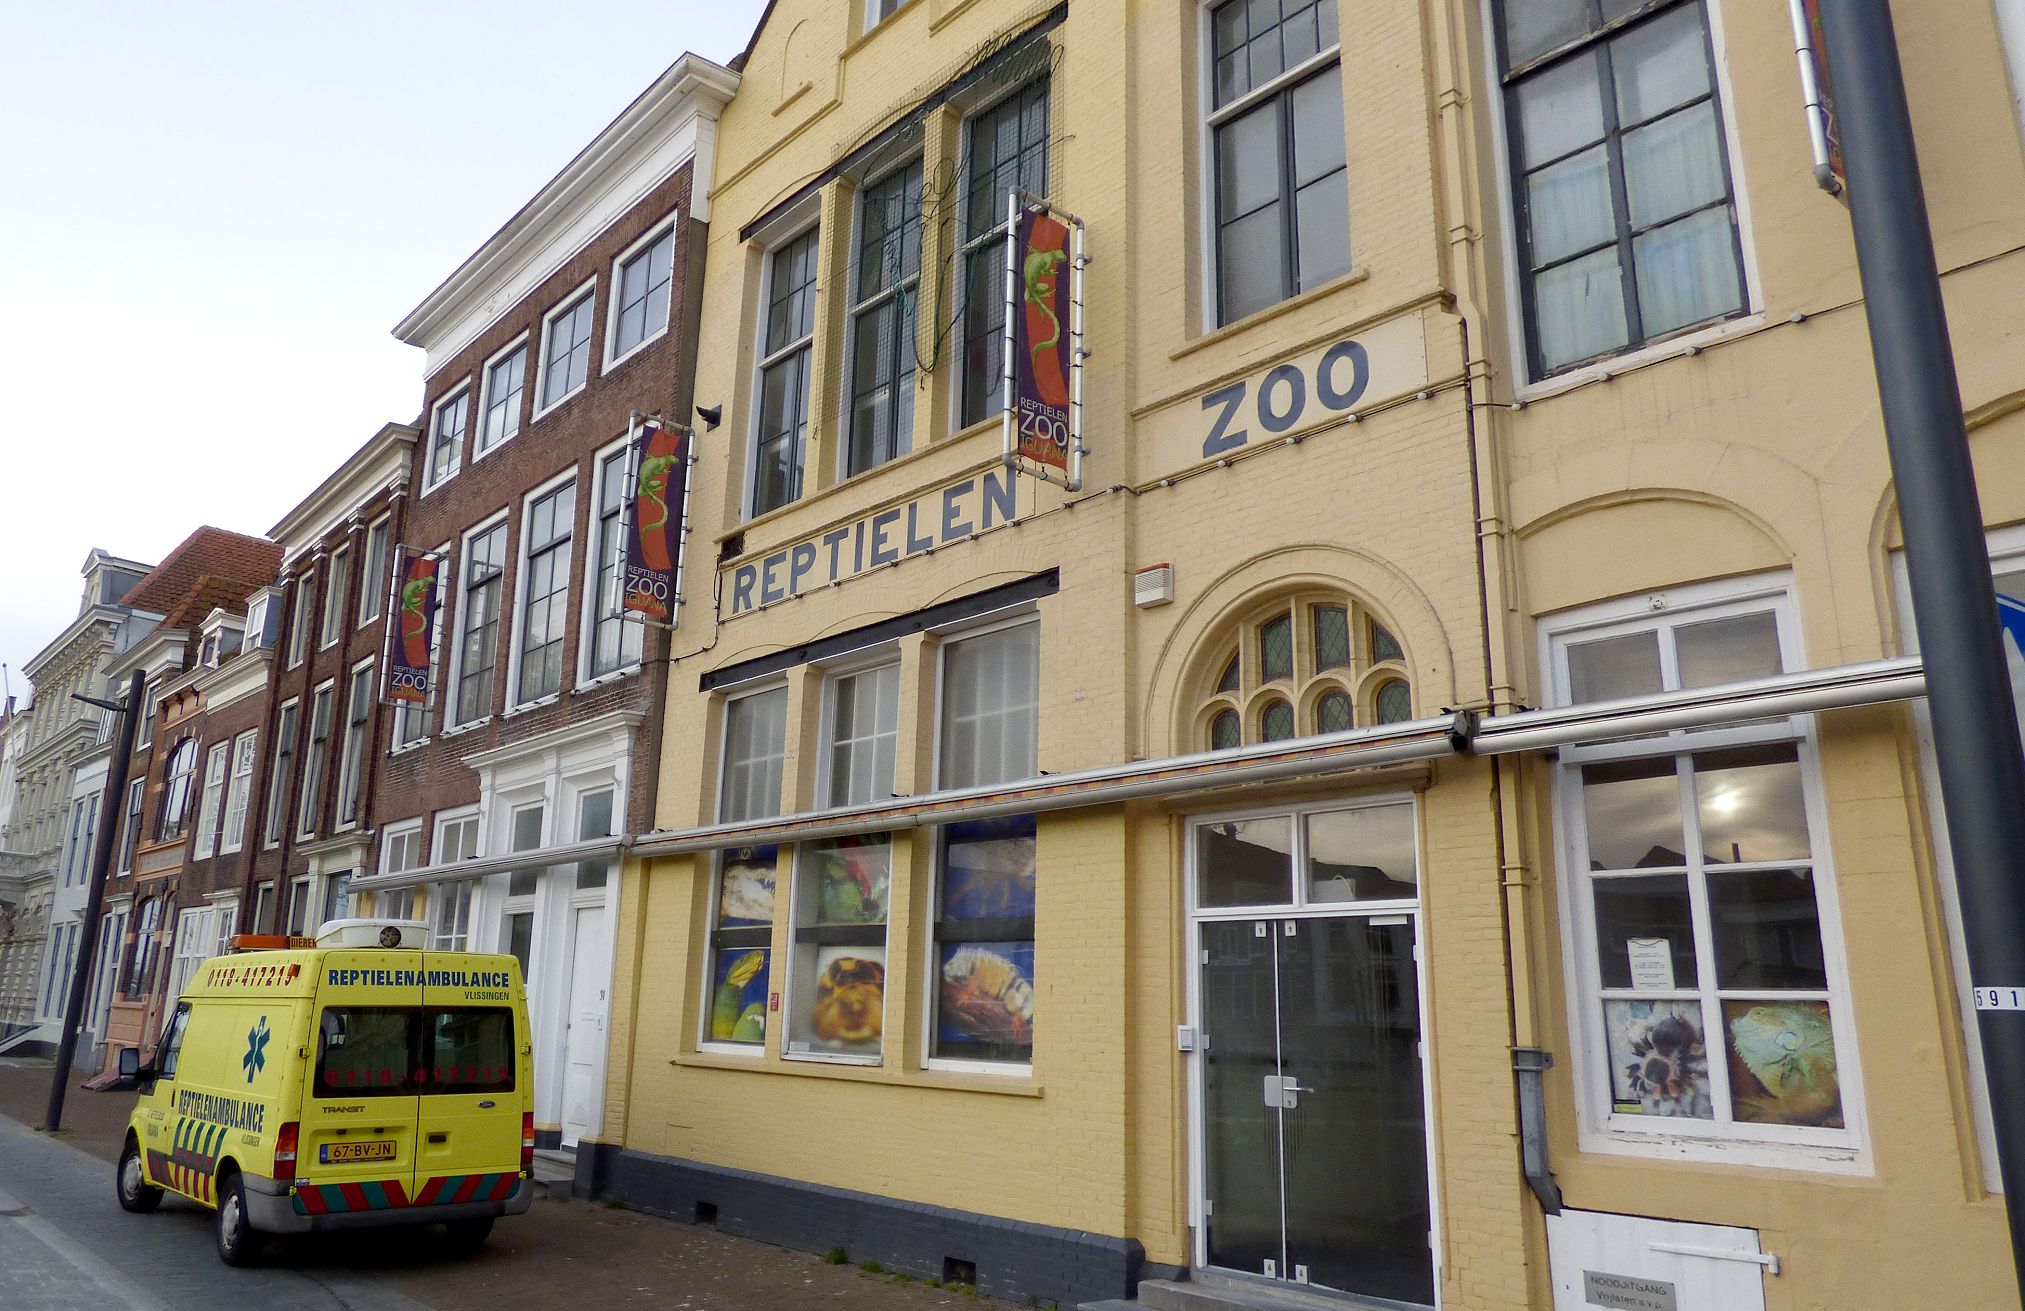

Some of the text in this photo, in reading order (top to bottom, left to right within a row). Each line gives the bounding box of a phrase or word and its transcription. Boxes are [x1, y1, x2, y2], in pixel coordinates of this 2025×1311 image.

[1202, 341, 1369, 458] ZOO
[1020, 397, 1068, 423] REPTIELEN
[1021, 408, 1068, 447] ZOO
[1020, 434, 1068, 459] IGUANA
[732, 466, 1016, 614] REPTIELEN
[627, 564, 669, 583] REPTIELEN
[626, 573, 667, 600] ZOO
[625, 593, 667, 612] IGUANA
[393, 665, 428, 676] REPTIELEN
[392, 671, 426, 690] ZOO
[328, 969, 509, 988] REPTIELENAMBULANCE
[464, 991, 510, 1001] VLISSINGEN
[179, 1090, 264, 1134] REPTIELENAMBULANCE
[322, 1105, 366, 1114] TRANSIT
[333, 1143, 391, 1158] 67-BV-JN
